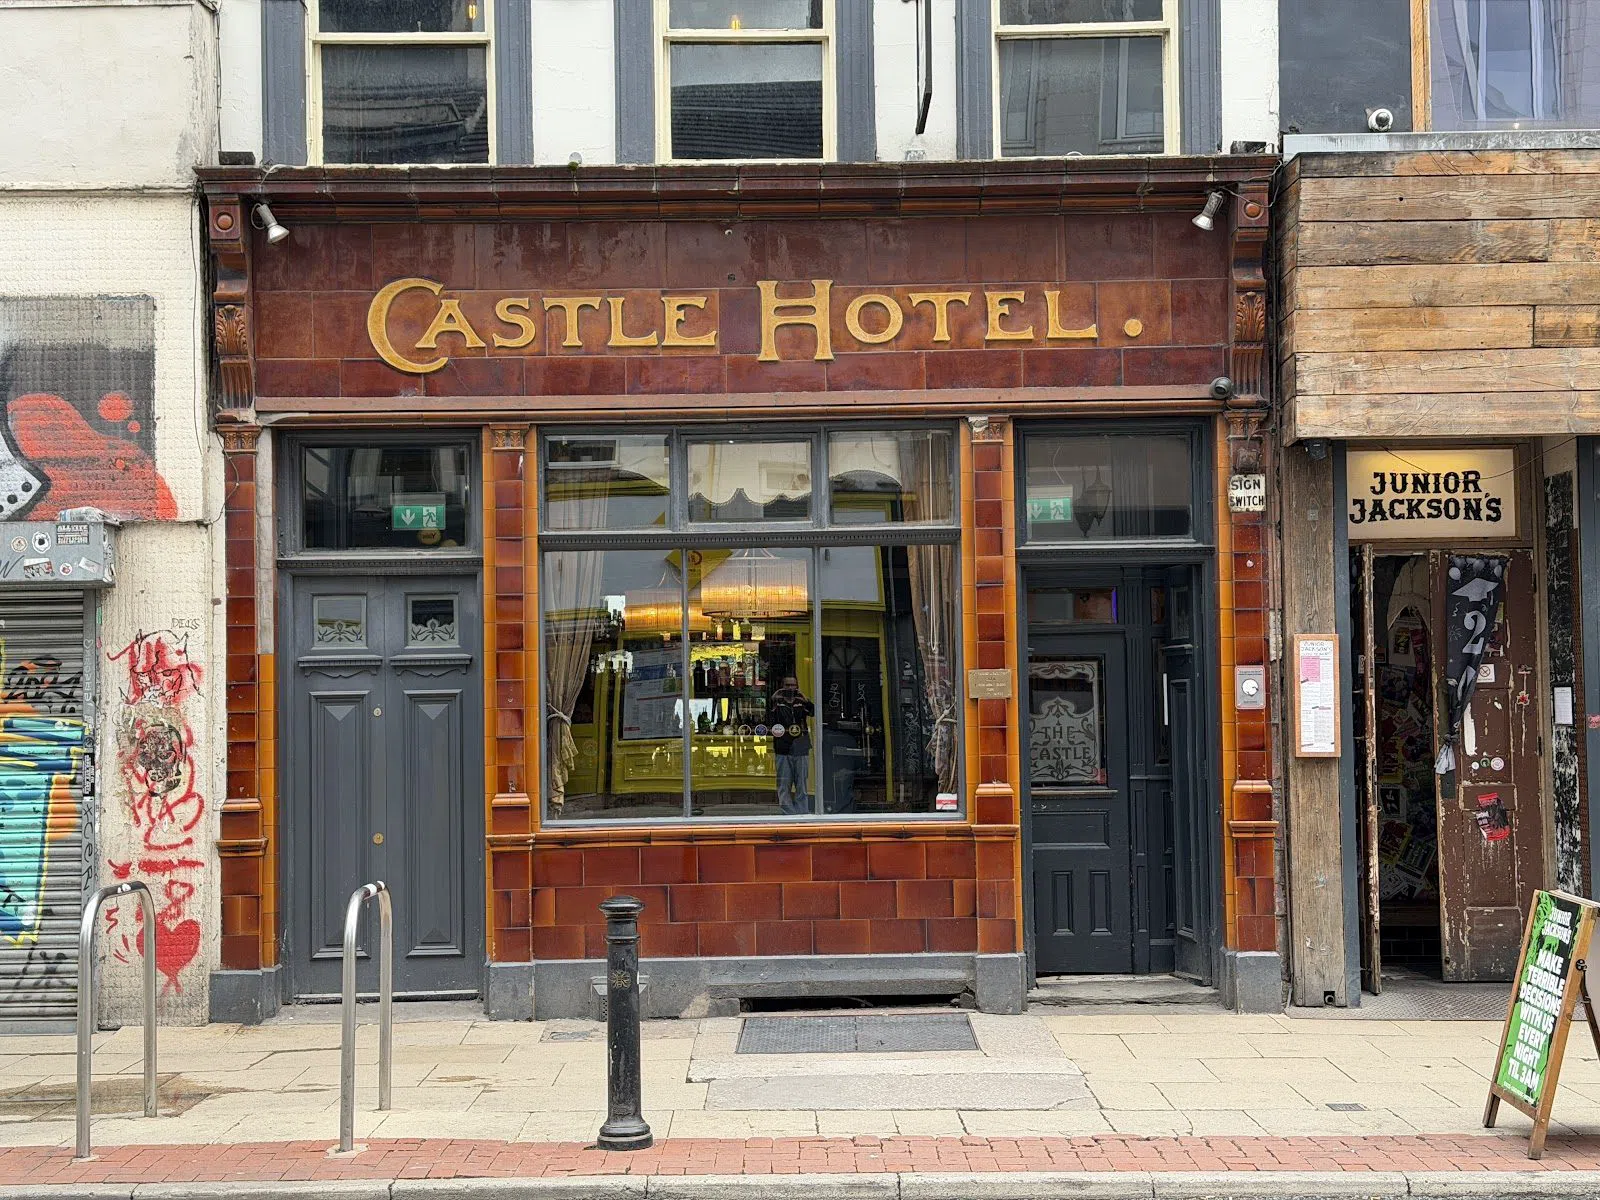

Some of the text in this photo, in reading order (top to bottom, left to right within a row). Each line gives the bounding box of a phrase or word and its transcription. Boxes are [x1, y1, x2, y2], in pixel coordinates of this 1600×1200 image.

[367, 277, 717, 373] CASTLE
[1230, 479, 1261, 490] SIGN
[1370, 470, 1482, 495] JUNIOR
[1229, 495, 1264, 507] SWITCH
[1349, 492, 1501, 524] JACKSON'S
[1041, 725, 1076, 740] THE
[1030, 746, 1091, 761] CASTLE
[1537, 949, 1564, 975] MAKE
[1527, 964, 1566, 997] TERRIBLE
[1520, 981, 1562, 1017] DECISIONS
[1520, 1001, 1555, 1035] WITH US
[1518, 1021, 1547, 1050] EVERY
[1513, 1040, 1541, 1069] NIGHT
[1520, 1065, 1540, 1092] 3AM
